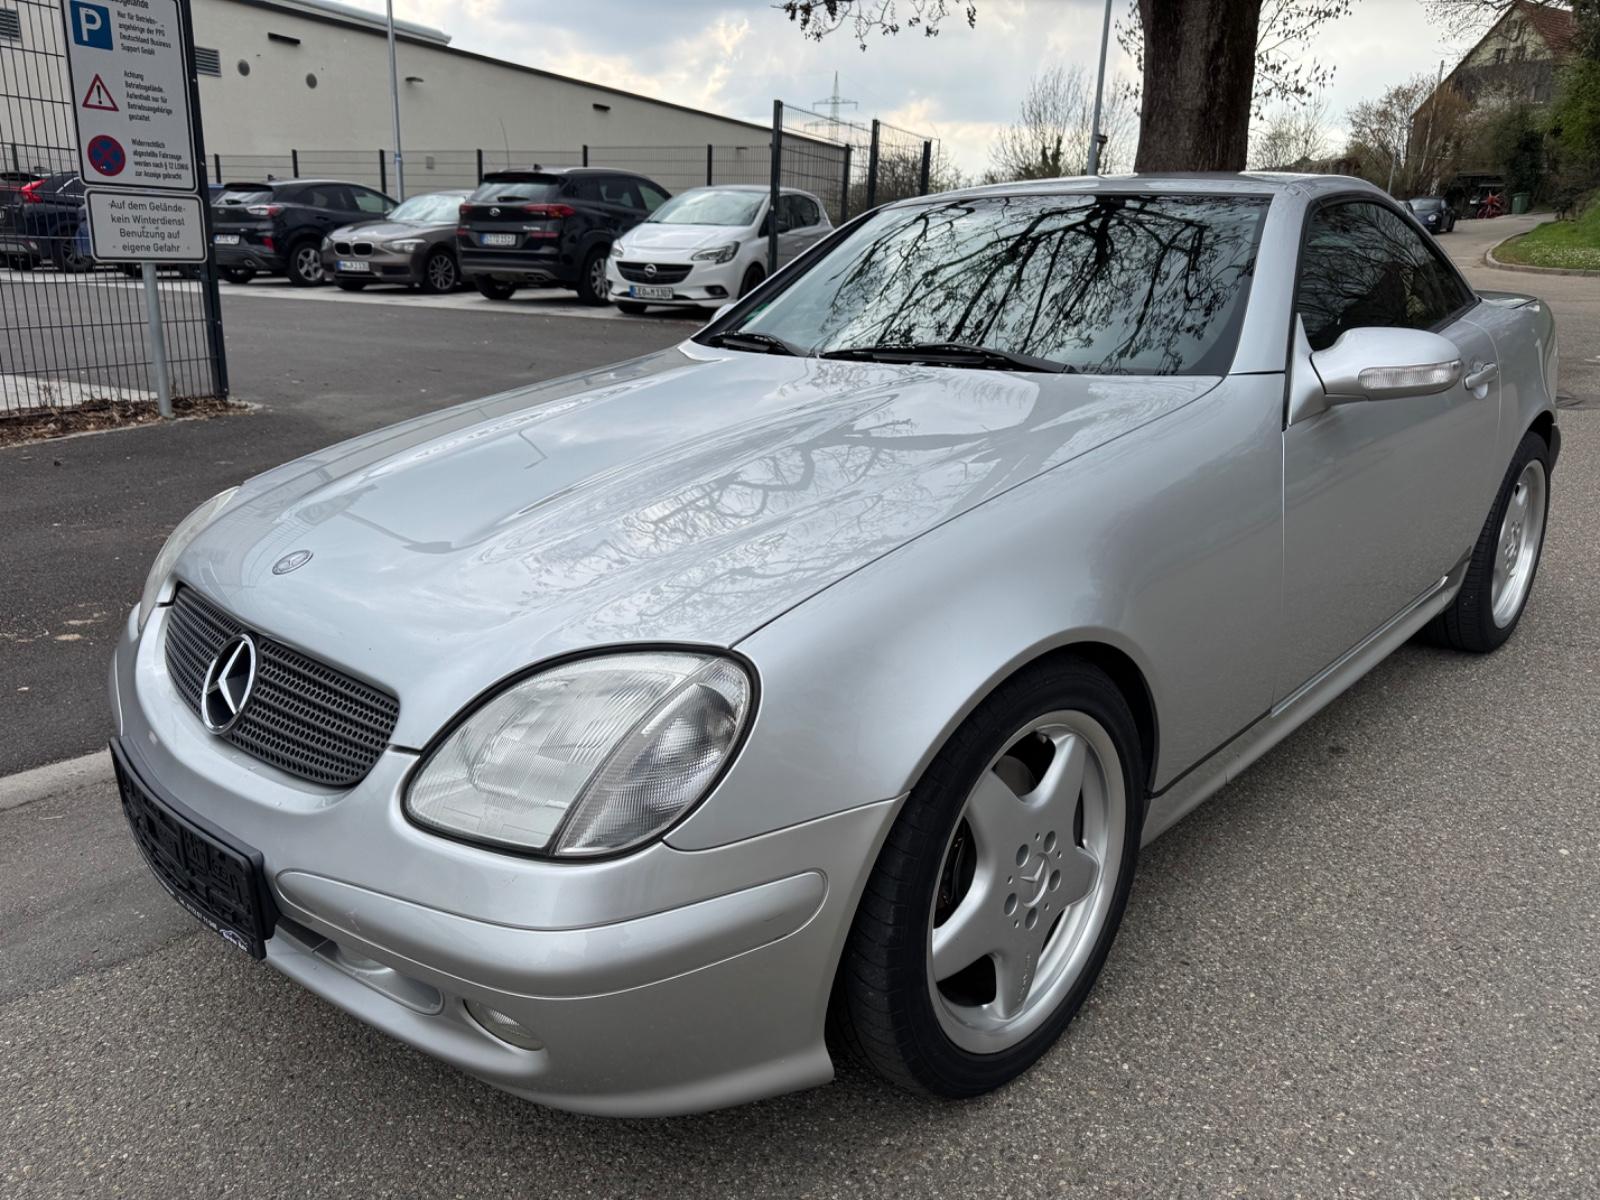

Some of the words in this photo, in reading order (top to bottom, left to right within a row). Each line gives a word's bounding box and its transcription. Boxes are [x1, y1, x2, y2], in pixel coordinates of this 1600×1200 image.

[111, 200, 125, 209] Auf
[128, 201, 147, 211] dem
[149, 202, 183, 212] Gelände
[111, 214, 131, 224] kein
[132, 215, 185, 226] Winterdienst
[120, 228, 166, 240] Benutzung
[167, 230, 180, 239] auf
[122, 243, 151, 253] eigene
[153, 243, 180, 252] Gefahr
